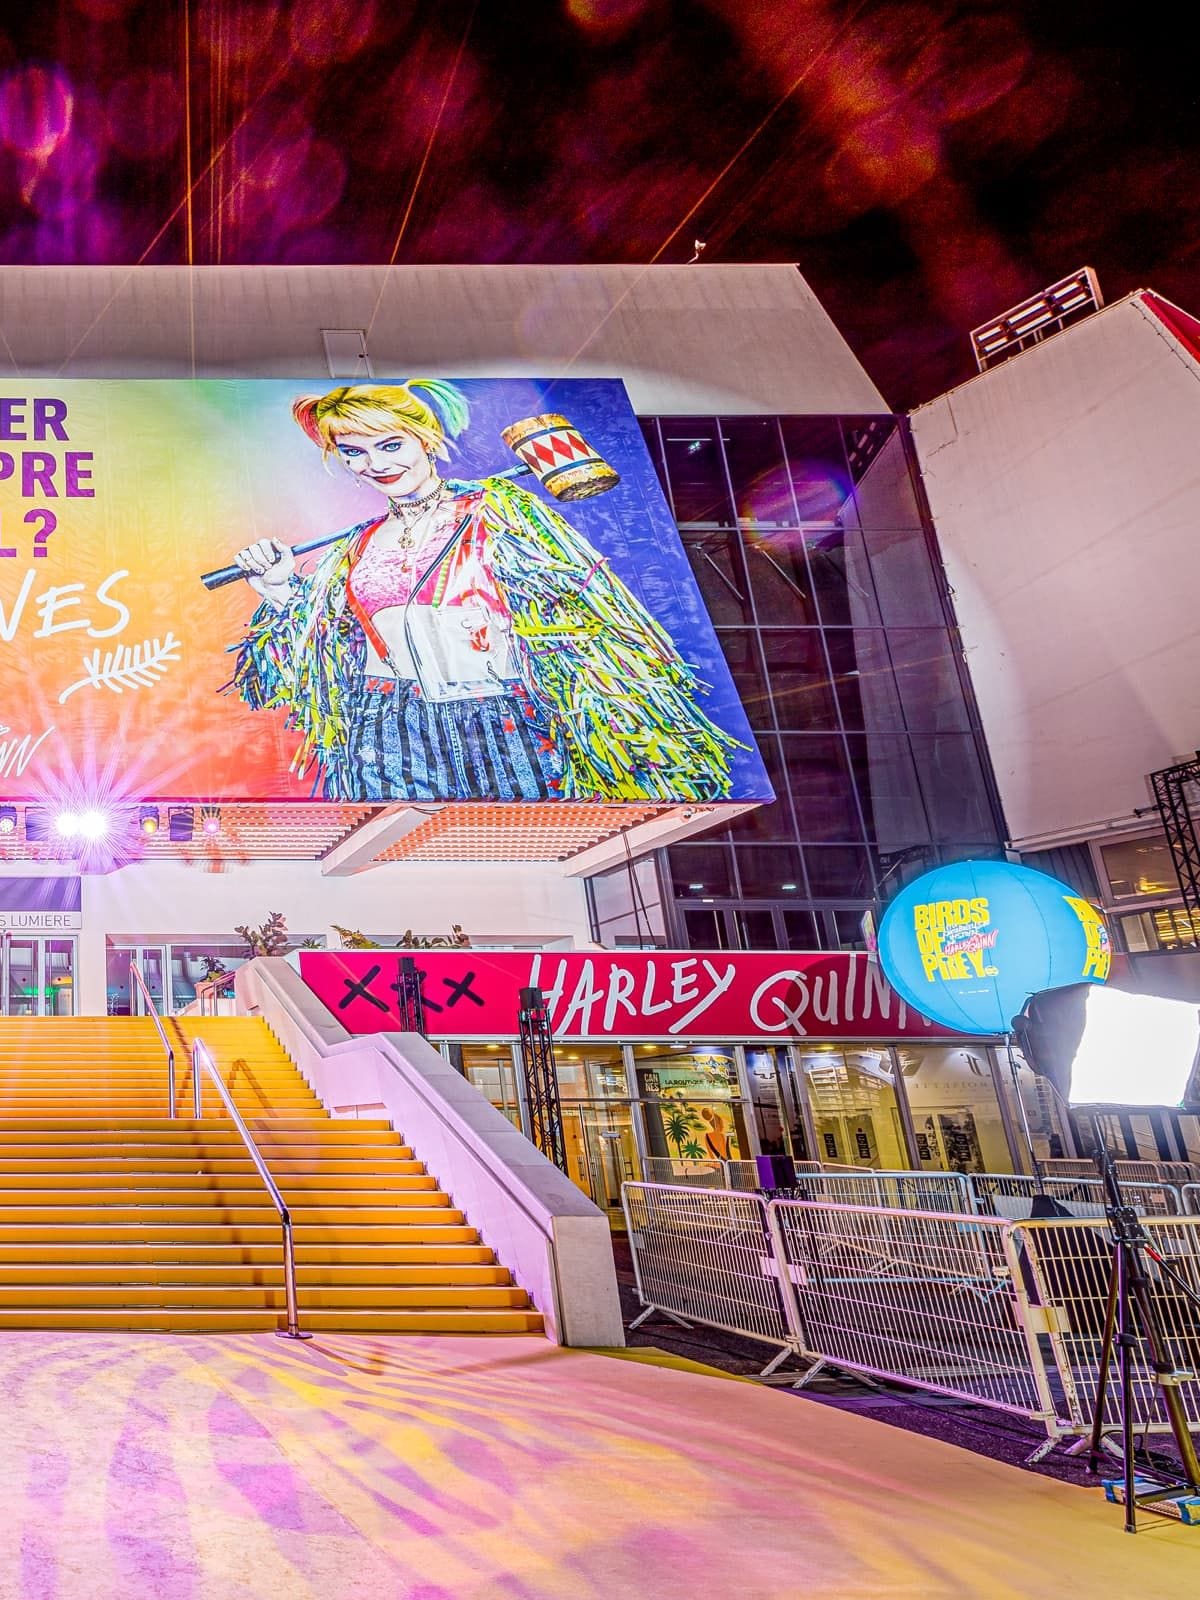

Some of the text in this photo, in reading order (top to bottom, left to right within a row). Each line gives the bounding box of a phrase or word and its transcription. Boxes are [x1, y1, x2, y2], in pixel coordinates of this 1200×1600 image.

[11, 914, 71, 927] LUMIERE
[913, 897, 990, 930] BIRDS
[916, 926, 946, 956] OF
[920, 951, 987, 983] PREY
[520, 954, 736, 1036] HARLEY
